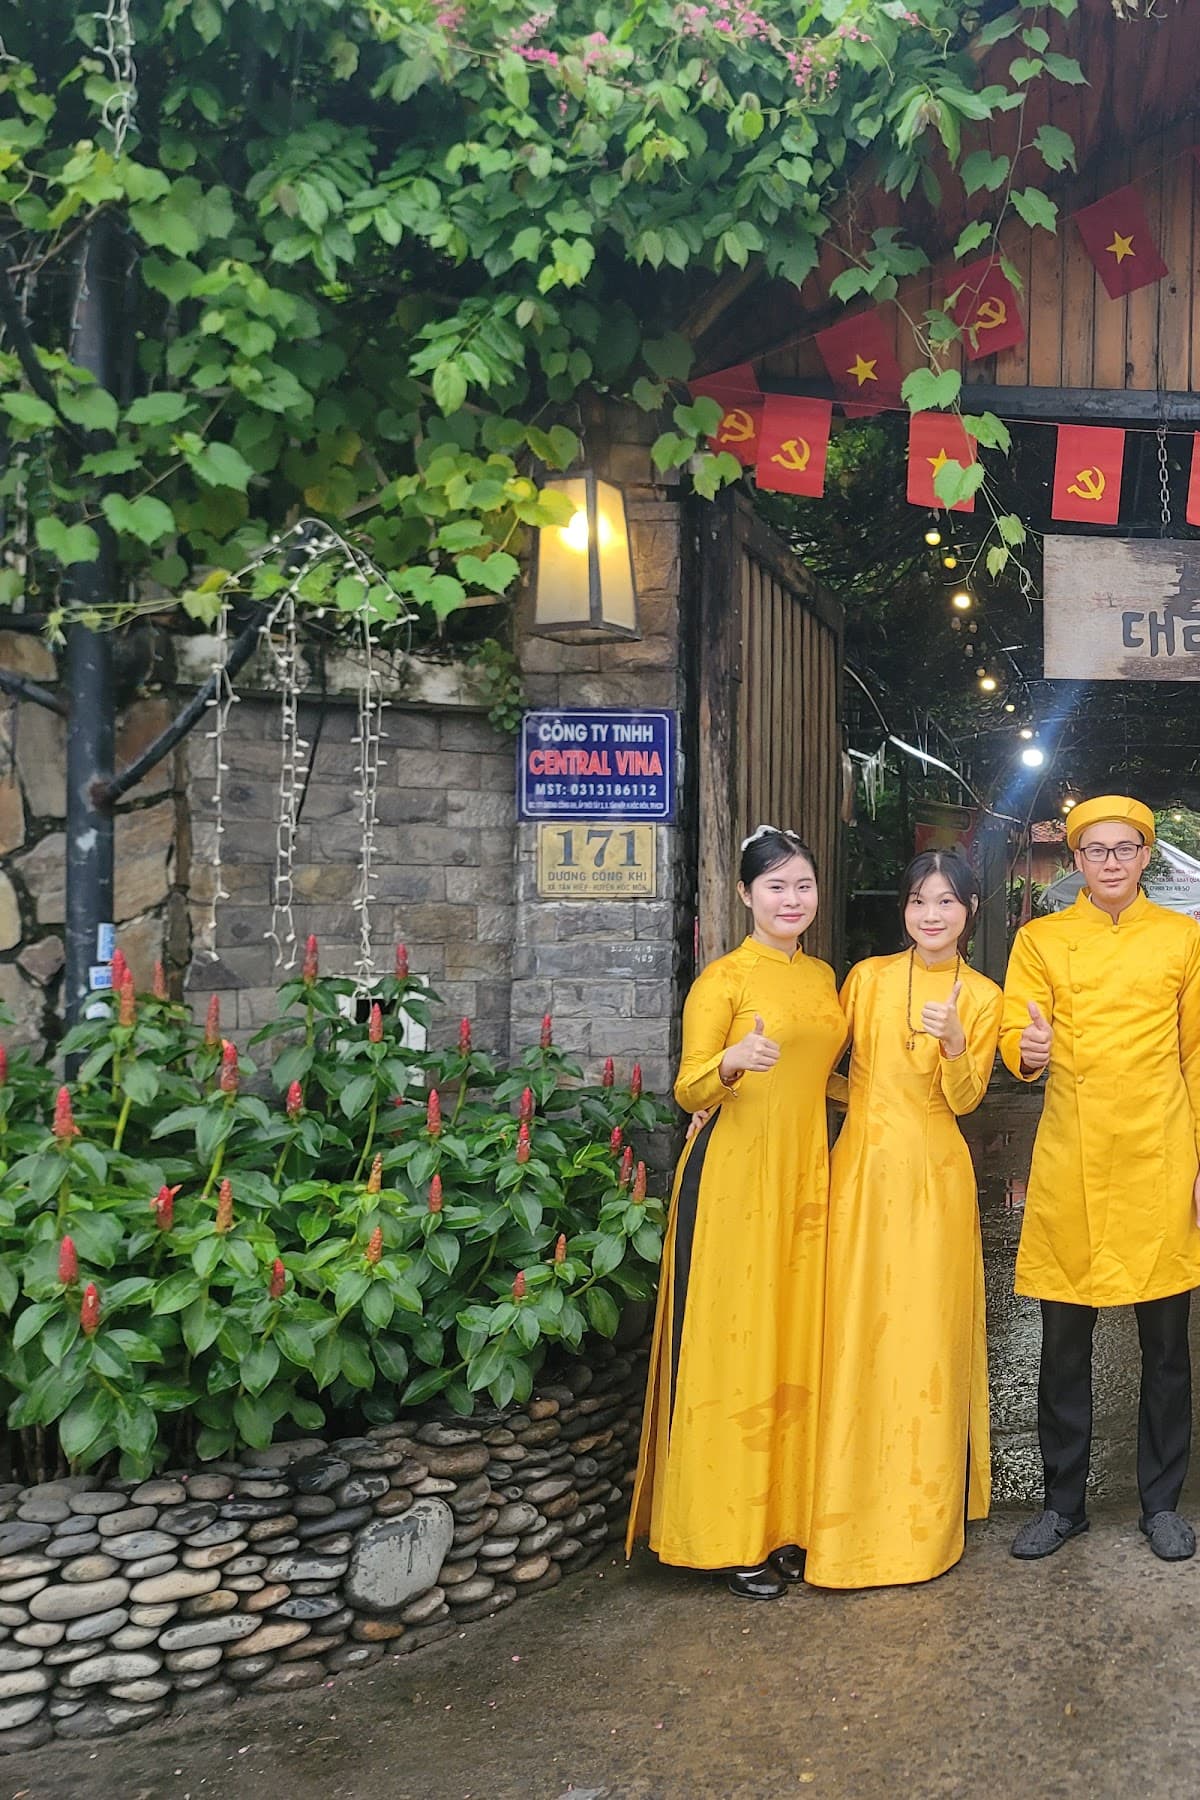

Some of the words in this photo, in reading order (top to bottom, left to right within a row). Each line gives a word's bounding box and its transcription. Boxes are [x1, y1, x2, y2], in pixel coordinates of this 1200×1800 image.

[539, 719, 588, 742] CÔNG
[591, 724, 609, 742] TY
[612, 724, 653, 743] TNHH
[529, 749, 611, 776] CENTRAL
[616, 751, 663, 776] VINA
[535, 784, 567, 796] MST:
[570, 784, 657, 796] 0313186112
[557, 829, 642, 867] 171
[628, 871, 647, 881] KHI
